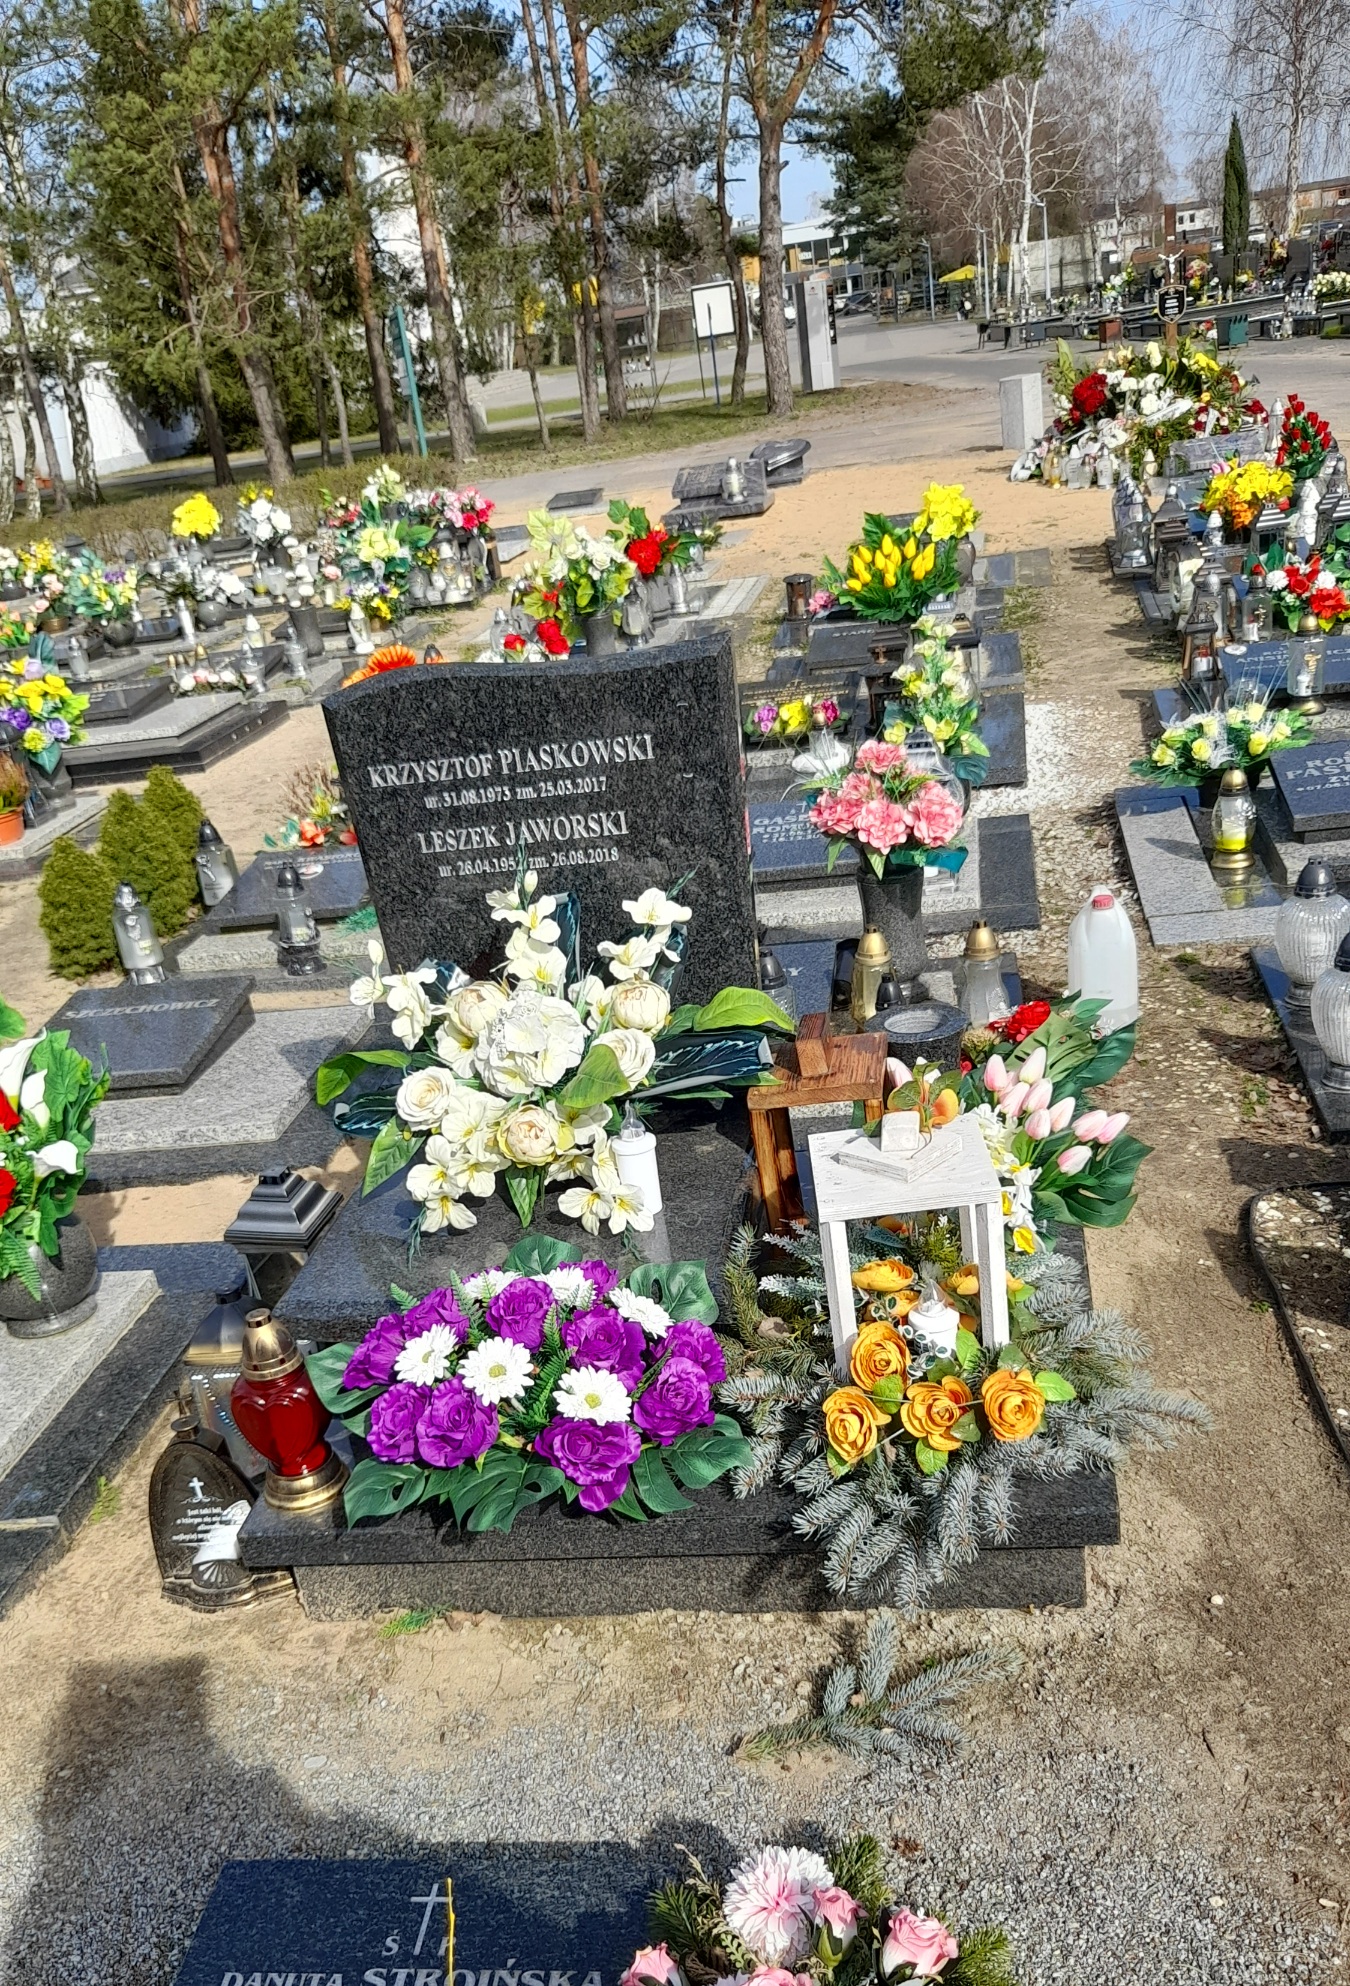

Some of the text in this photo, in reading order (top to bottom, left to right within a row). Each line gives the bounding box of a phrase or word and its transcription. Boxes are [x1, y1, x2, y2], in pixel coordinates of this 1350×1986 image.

[367, 734, 655, 788] KRZYSZTOF PIASKOWSKI
[424, 776, 607, 809] ur. 31.08.1973 zm. 25.03.2017
[417, 811, 629, 854] LESZEK JAWORSKI
[438, 847, 619, 877] ur. 26.04.195 zm. 26.08.2018
